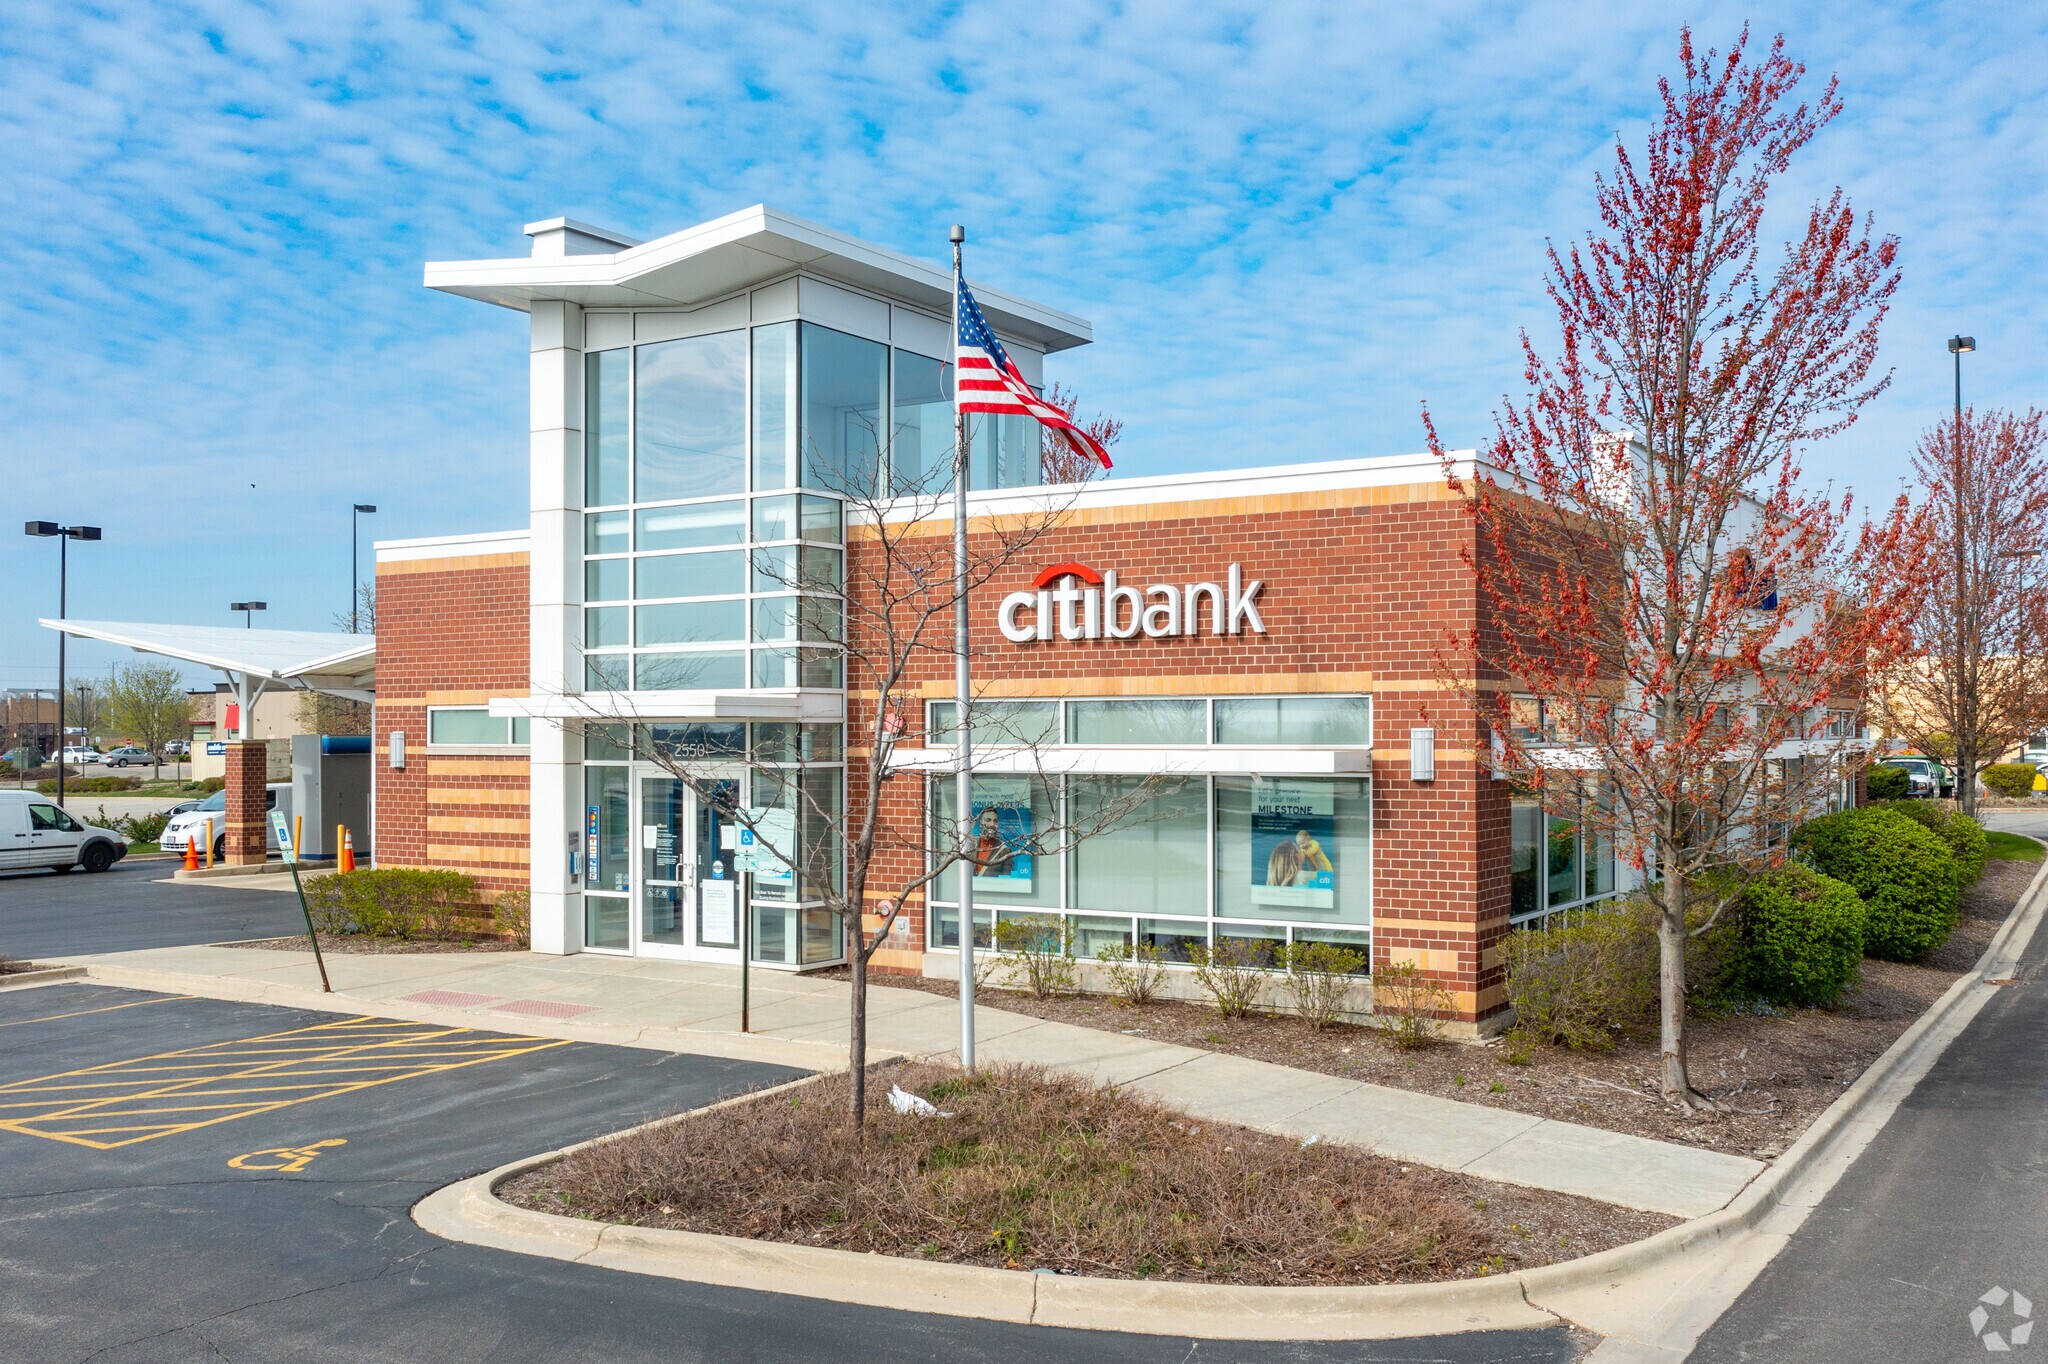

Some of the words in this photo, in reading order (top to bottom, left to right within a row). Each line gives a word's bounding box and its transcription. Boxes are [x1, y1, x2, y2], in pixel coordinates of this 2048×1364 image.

[998, 562, 1266, 643] citibank
[675, 743, 704, 757] 2550
[1258, 805, 1313, 815] MILESTONE
